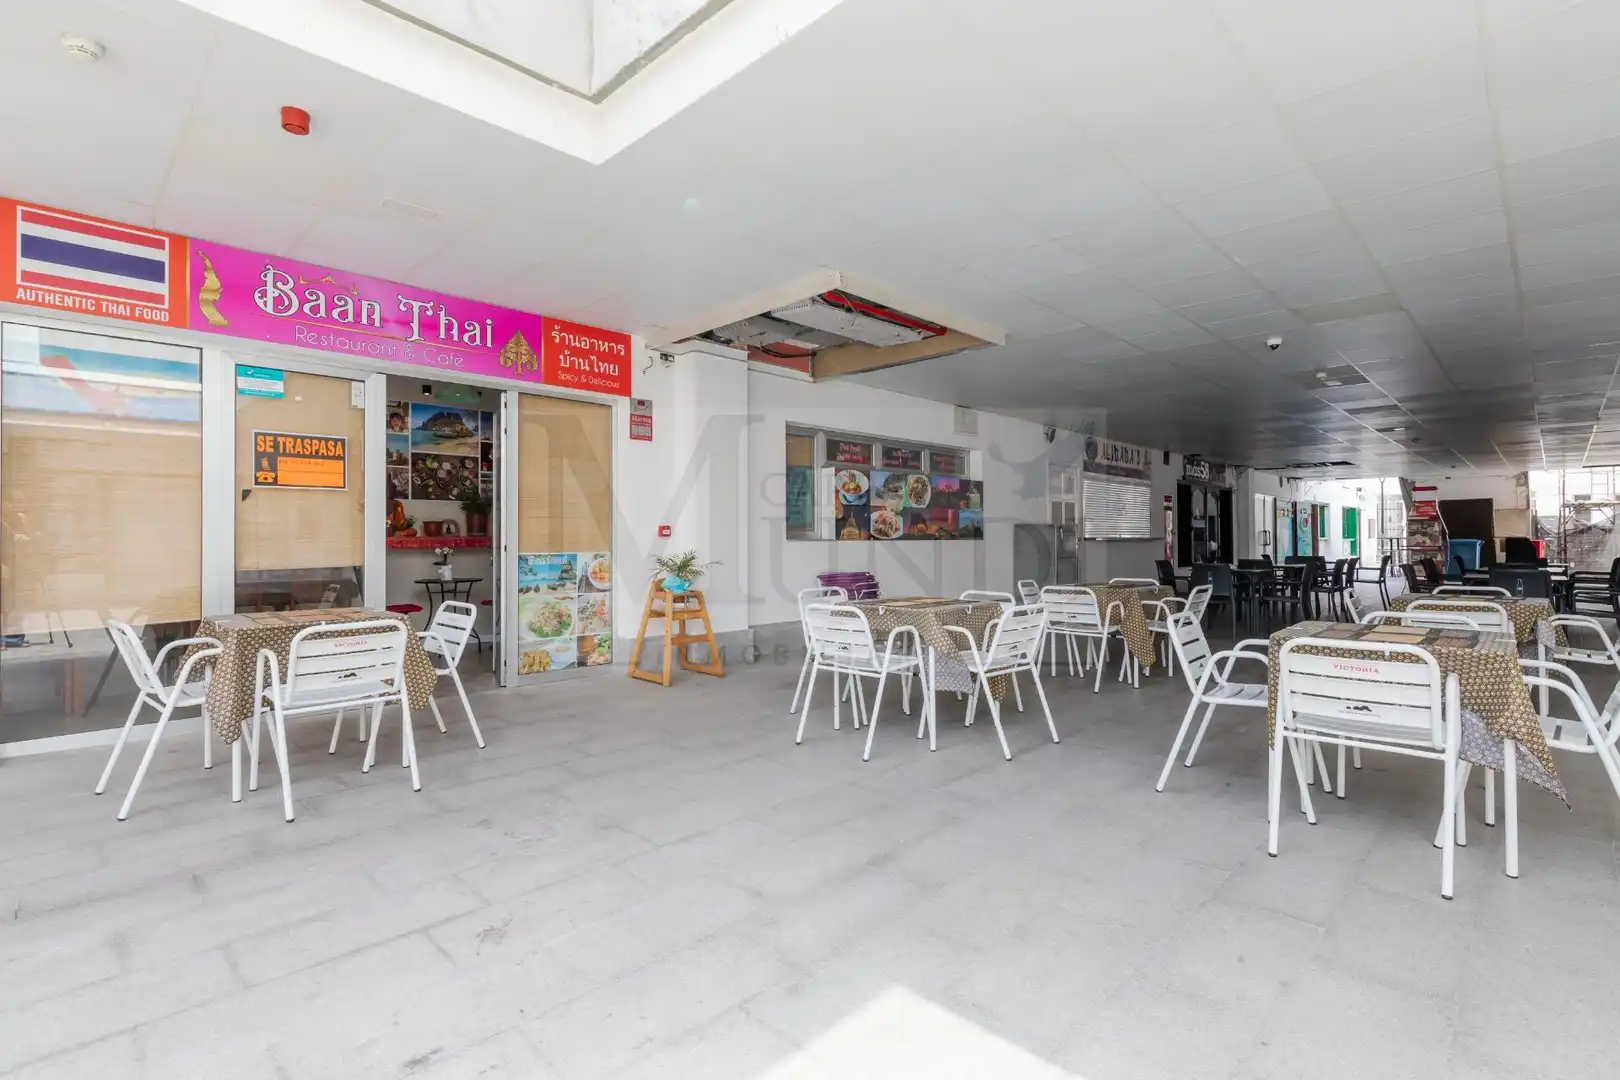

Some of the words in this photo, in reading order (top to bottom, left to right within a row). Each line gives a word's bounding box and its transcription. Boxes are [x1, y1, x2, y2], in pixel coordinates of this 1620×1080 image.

[16, 287, 96, 311] AUTHENTIC
[102, 301, 131, 316] THAI
[135, 307, 169, 322] FOOD
[253, 264, 383, 328] Baan
[397, 293, 494, 348] Thai
[294, 324, 397, 359] Restaurant
[403, 343, 416, 361] &
[551, 324, 625, 356] ร้านอาหาร
[559, 349, 619, 376] บ้านไทย
[557, 371, 579, 384] Spicy
[588, 376, 620, 388] Delicious
[256, 435, 274, 453] SE
[277, 437, 344, 457] TRASPASA
[1333, 663, 1380, 674] VICTORIA
